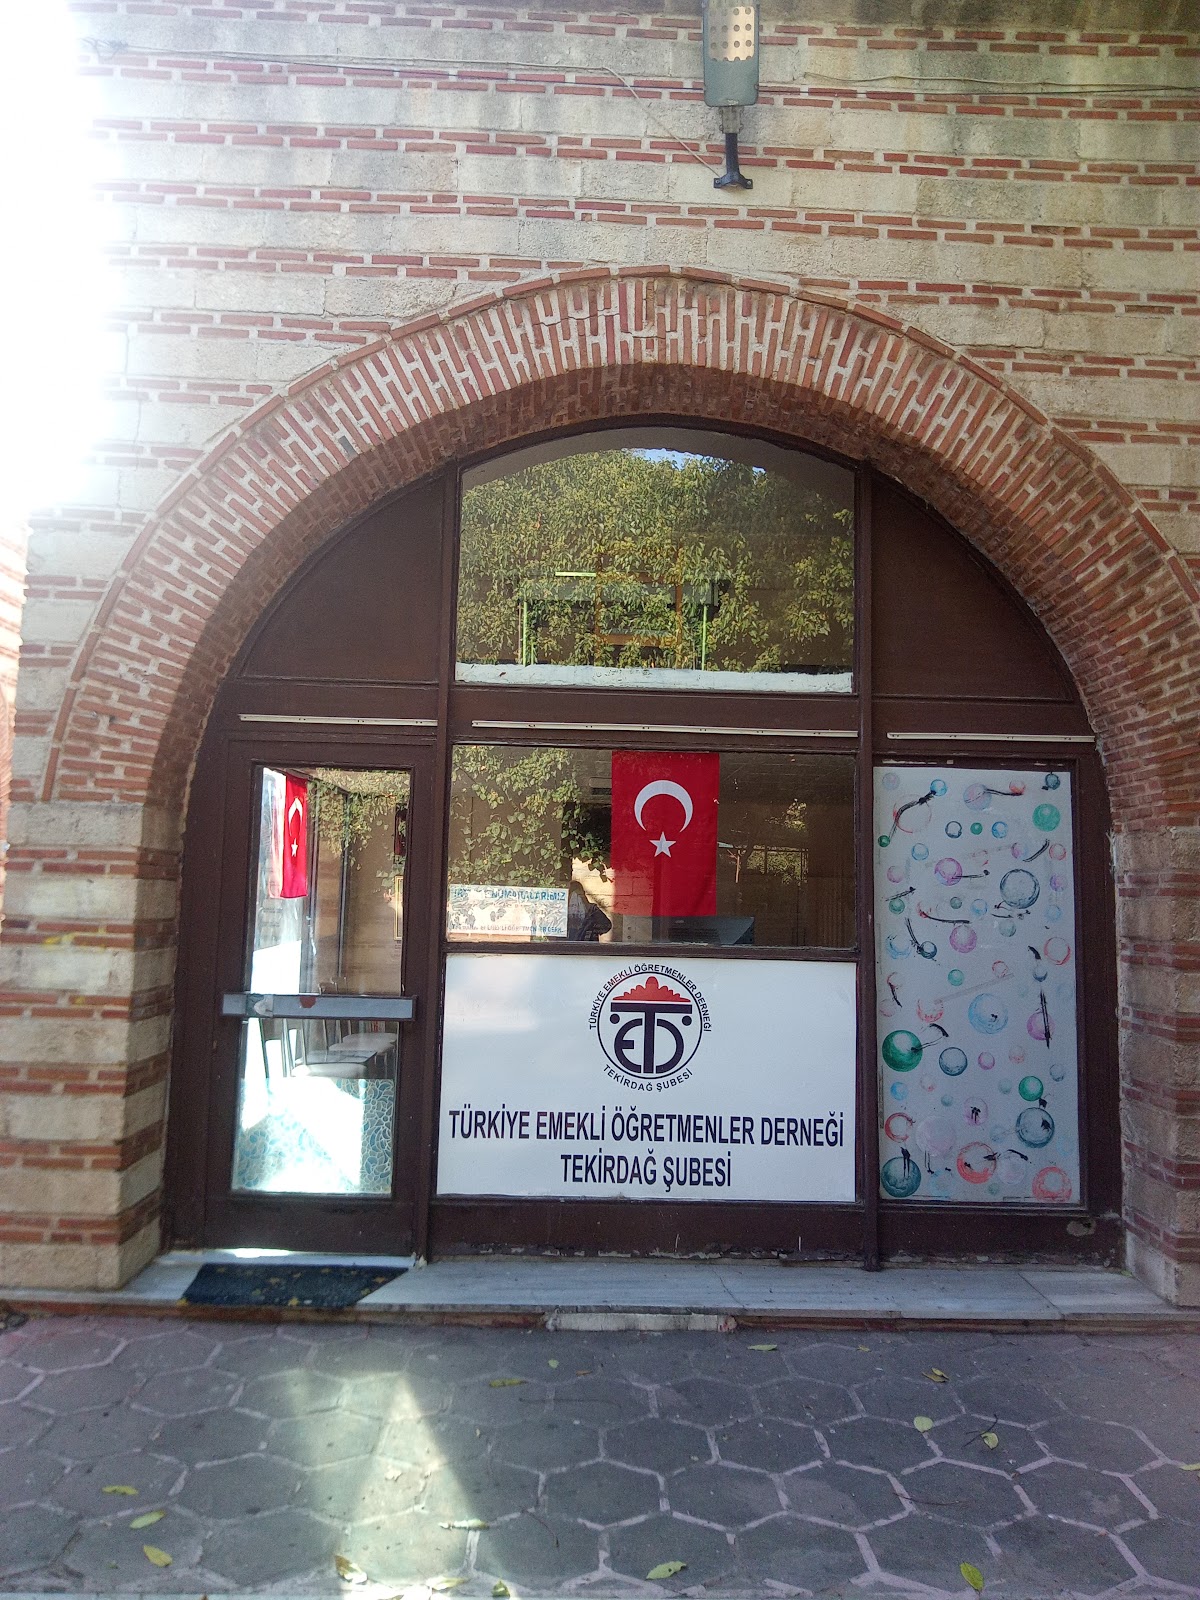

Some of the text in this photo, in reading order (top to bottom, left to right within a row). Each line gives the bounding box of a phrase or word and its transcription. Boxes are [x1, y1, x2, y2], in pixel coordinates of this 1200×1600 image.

[588, 963, 712, 1032] TÜRKİYE EMEKLİ ÖĞRETMENLER DERNEĞİ
[603, 1064, 693, 1093] TEKİRDAĞ ŞUBESİ
[449, 1103, 844, 1147] TÜRKİYE EMEKLİ ÖĞRETMENLER DERNEĞİ
[560, 1147, 731, 1193] TEKİRDAĞ ŞUBESİ
